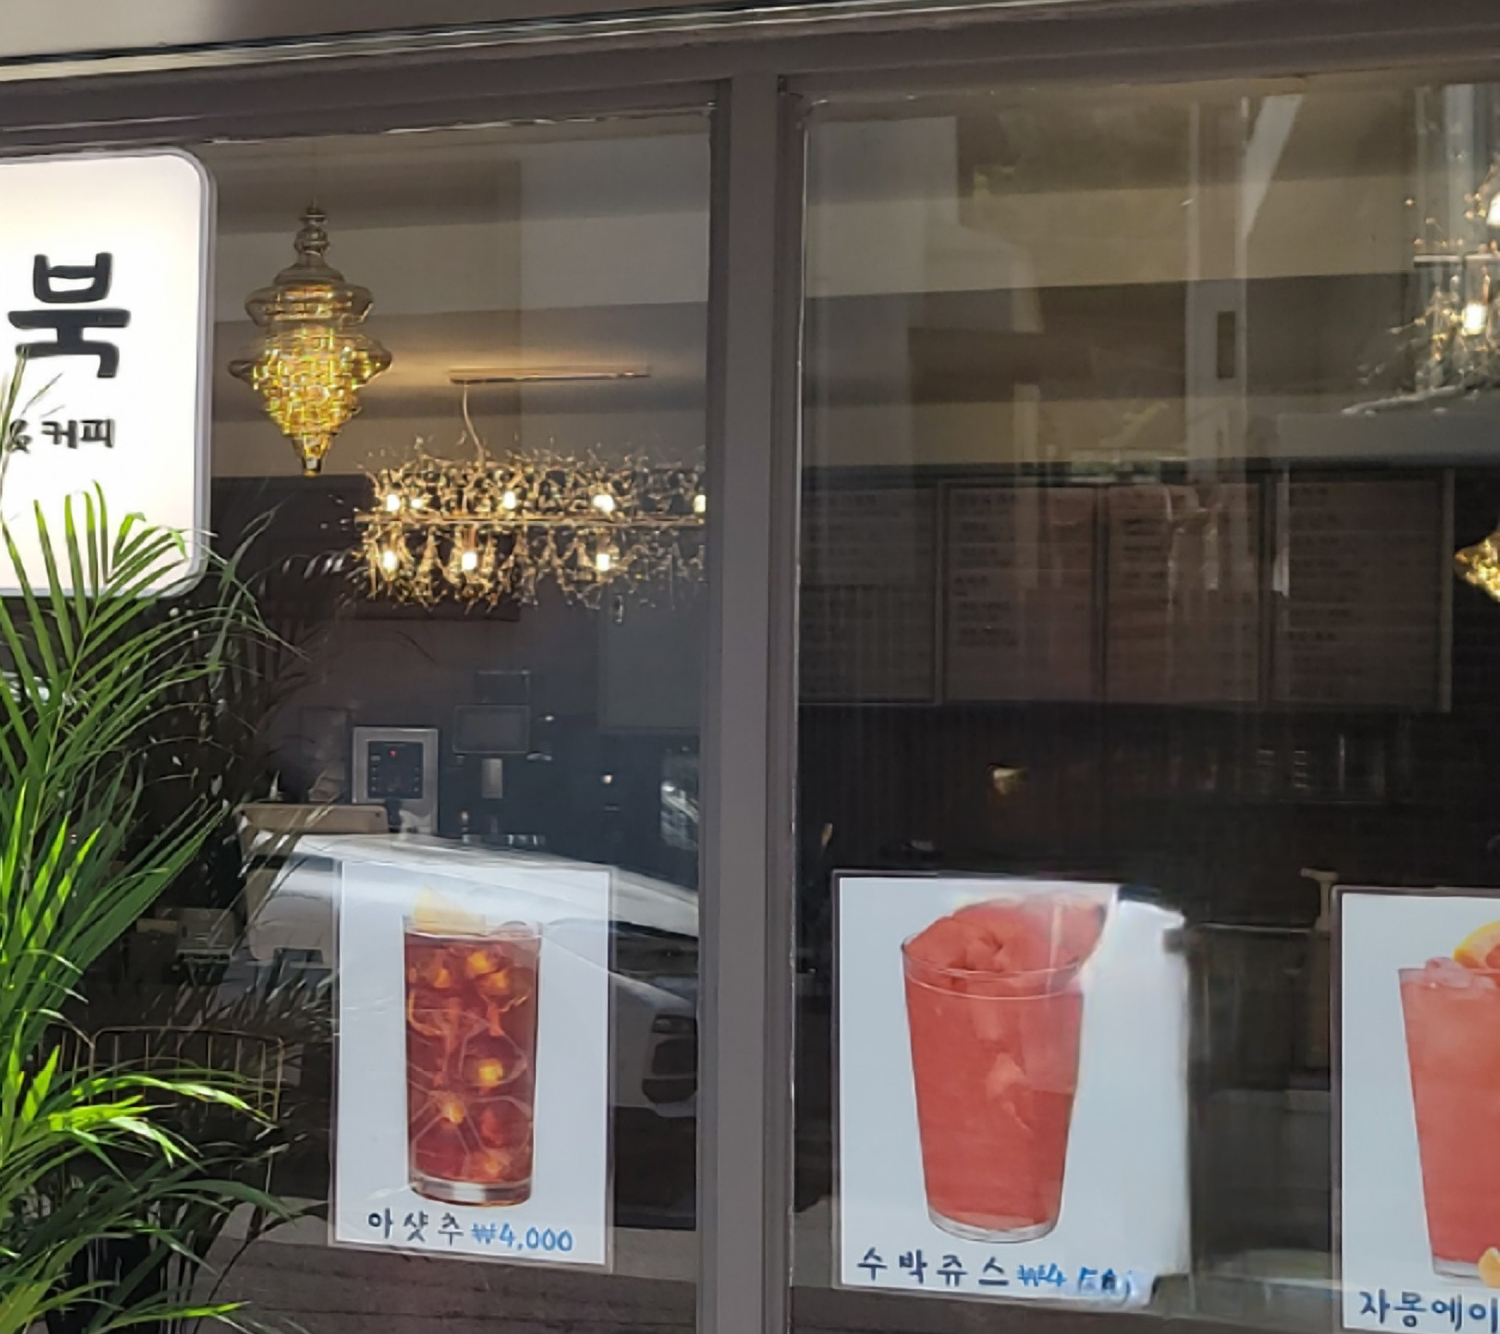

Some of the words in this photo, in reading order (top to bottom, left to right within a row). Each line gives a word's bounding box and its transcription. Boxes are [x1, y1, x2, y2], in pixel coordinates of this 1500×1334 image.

[470, 1222, 573, 1252] ₩4,000
[857, 1247, 1009, 1286] 수박쥬스
[1359, 1288, 1498, 1334] 자몽에이
